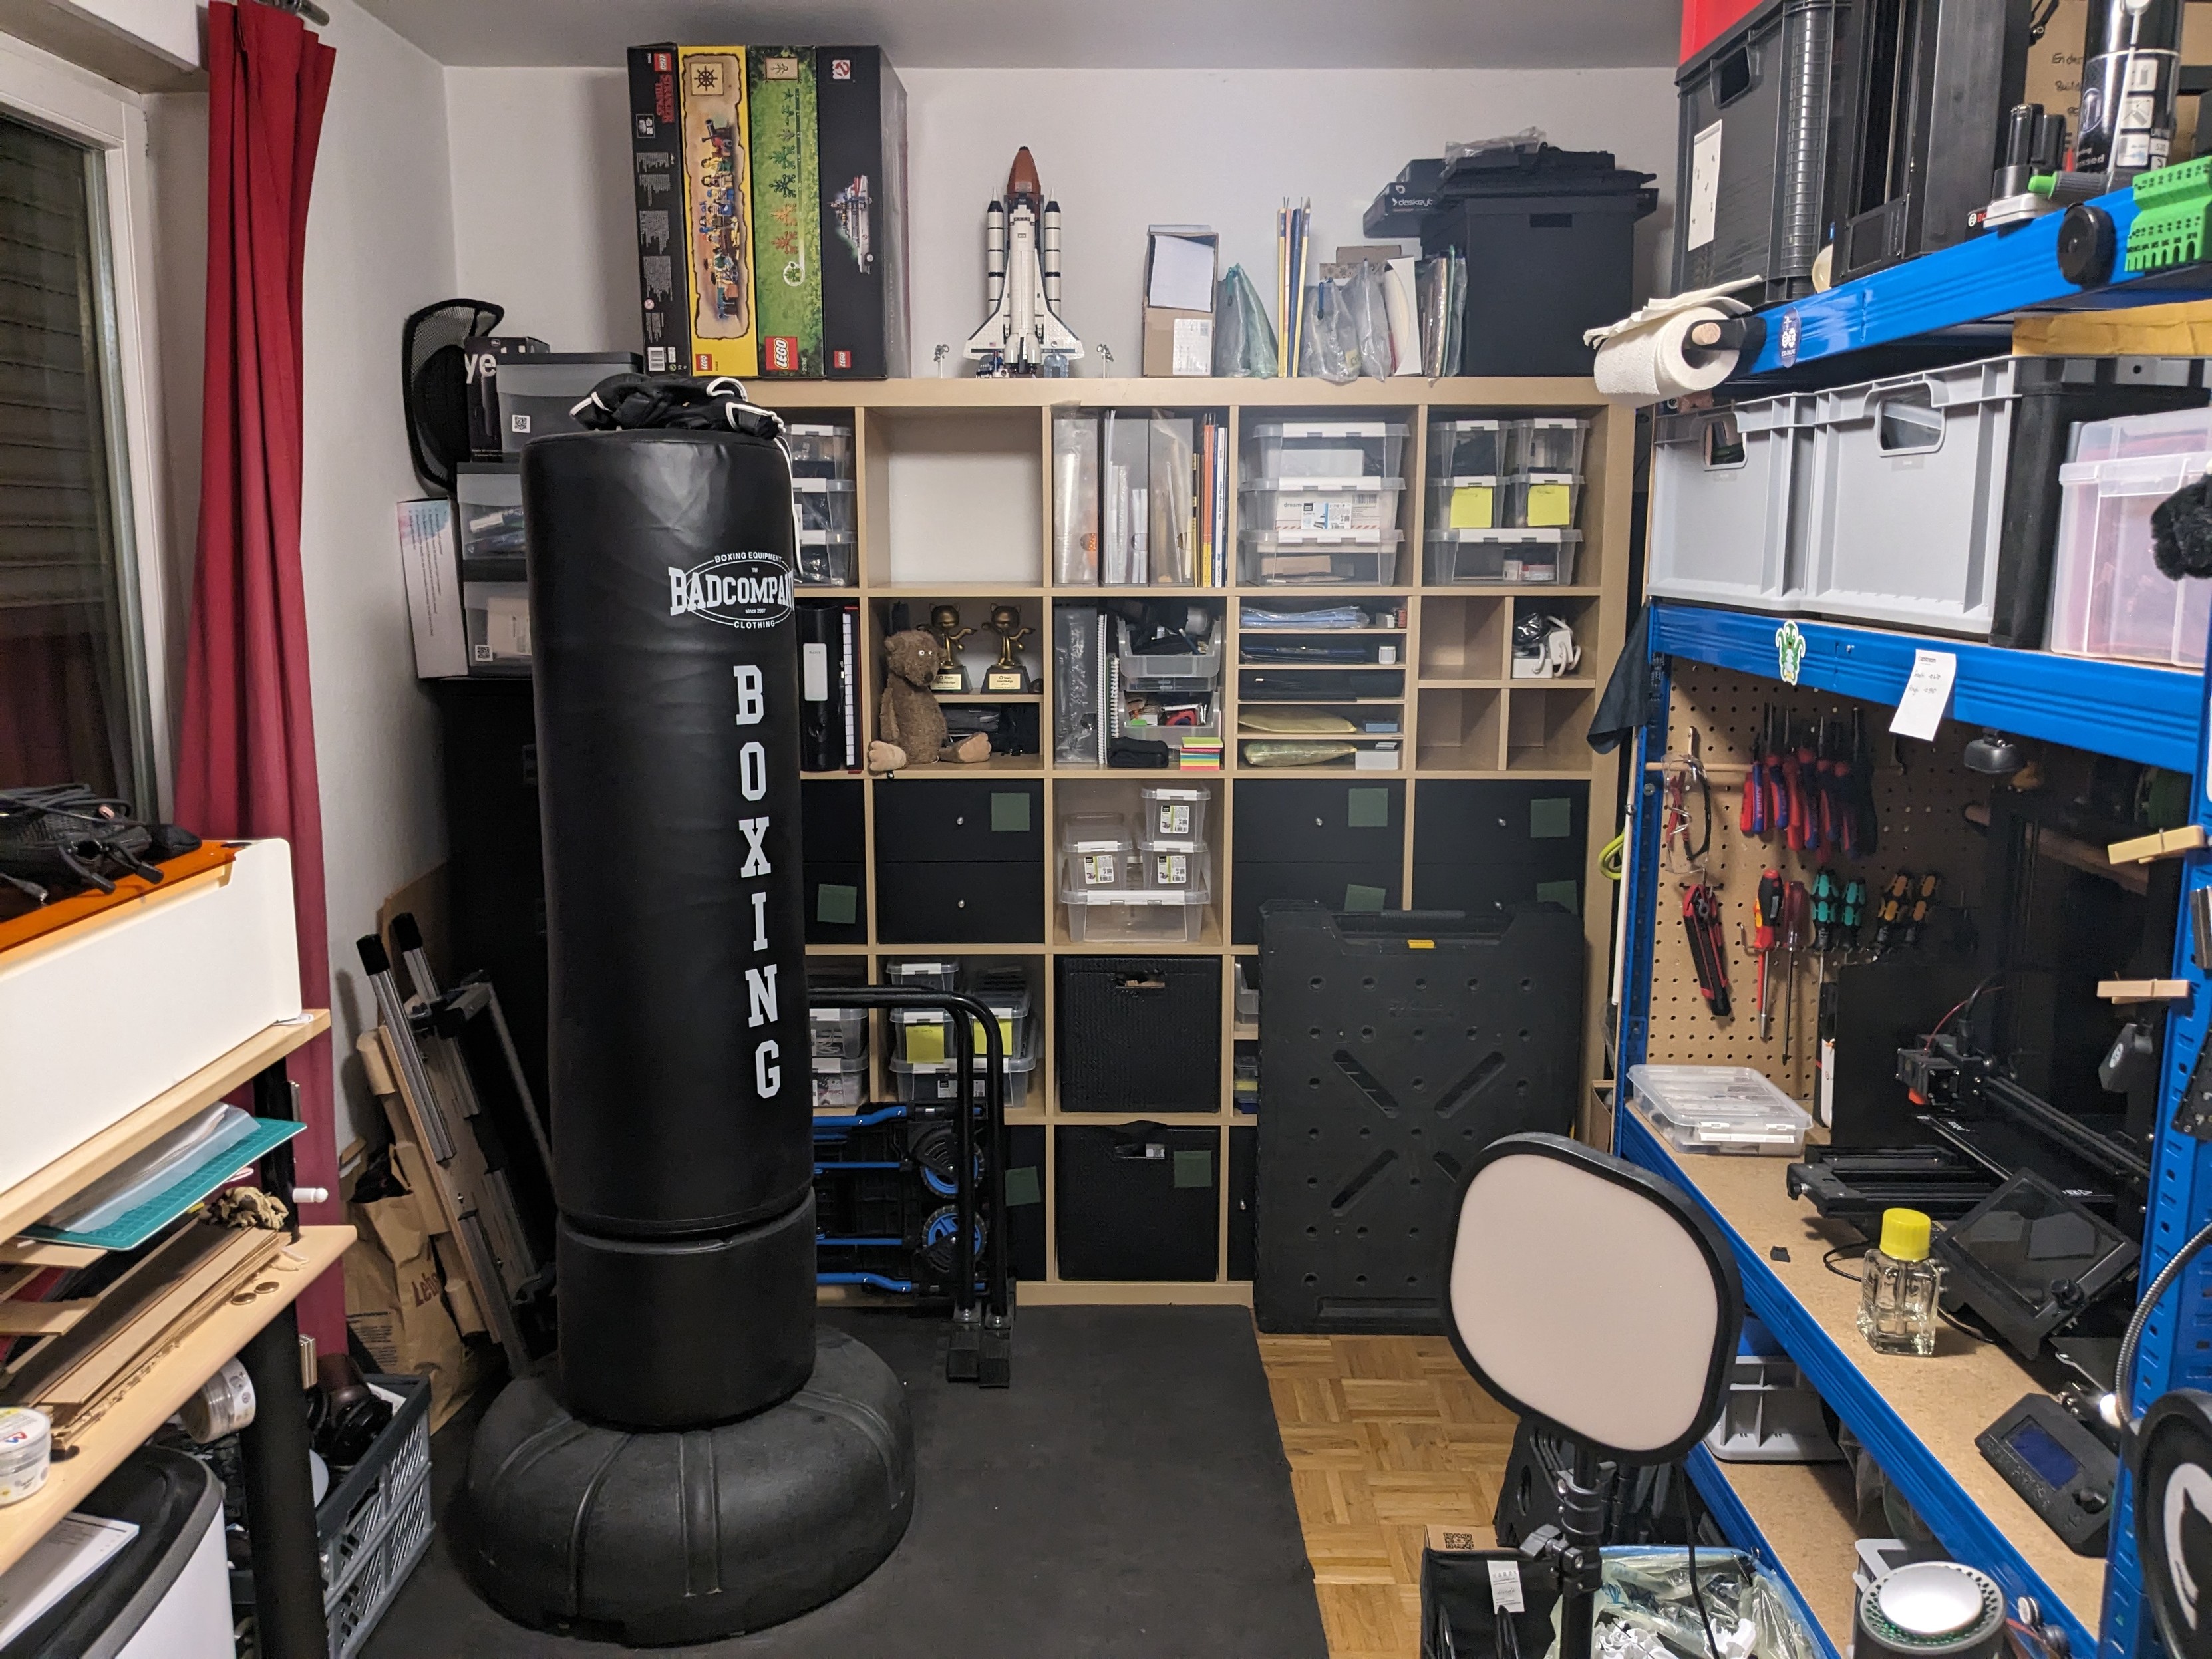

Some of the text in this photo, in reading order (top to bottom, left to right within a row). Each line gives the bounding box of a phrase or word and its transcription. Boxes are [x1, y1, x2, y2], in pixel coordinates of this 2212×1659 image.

[774, 338, 788, 369] LEGO
[714, 551, 782, 563] BOXING EQUIPMENT
[668, 567, 794, 616] BADCOMPAN
[734, 619, 776, 629] CLOTHING
[733, 665, 781, 1099] BOXING
